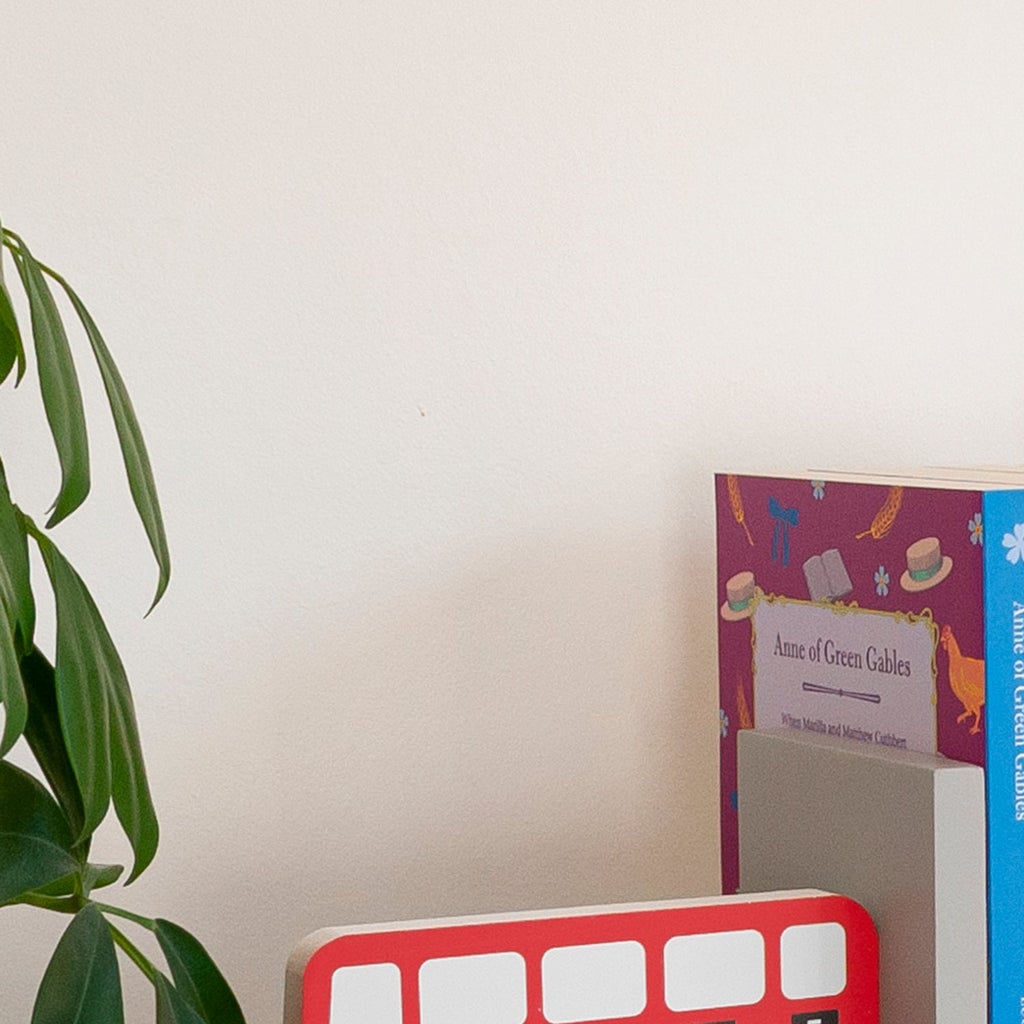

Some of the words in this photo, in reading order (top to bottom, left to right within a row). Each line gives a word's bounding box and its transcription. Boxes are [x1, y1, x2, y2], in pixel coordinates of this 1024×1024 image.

[773, 632, 806, 660] Anne
[808, 637, 823, 662] of
[824, 639, 862, 670] Green
[866, 646, 912, 677] Gables
